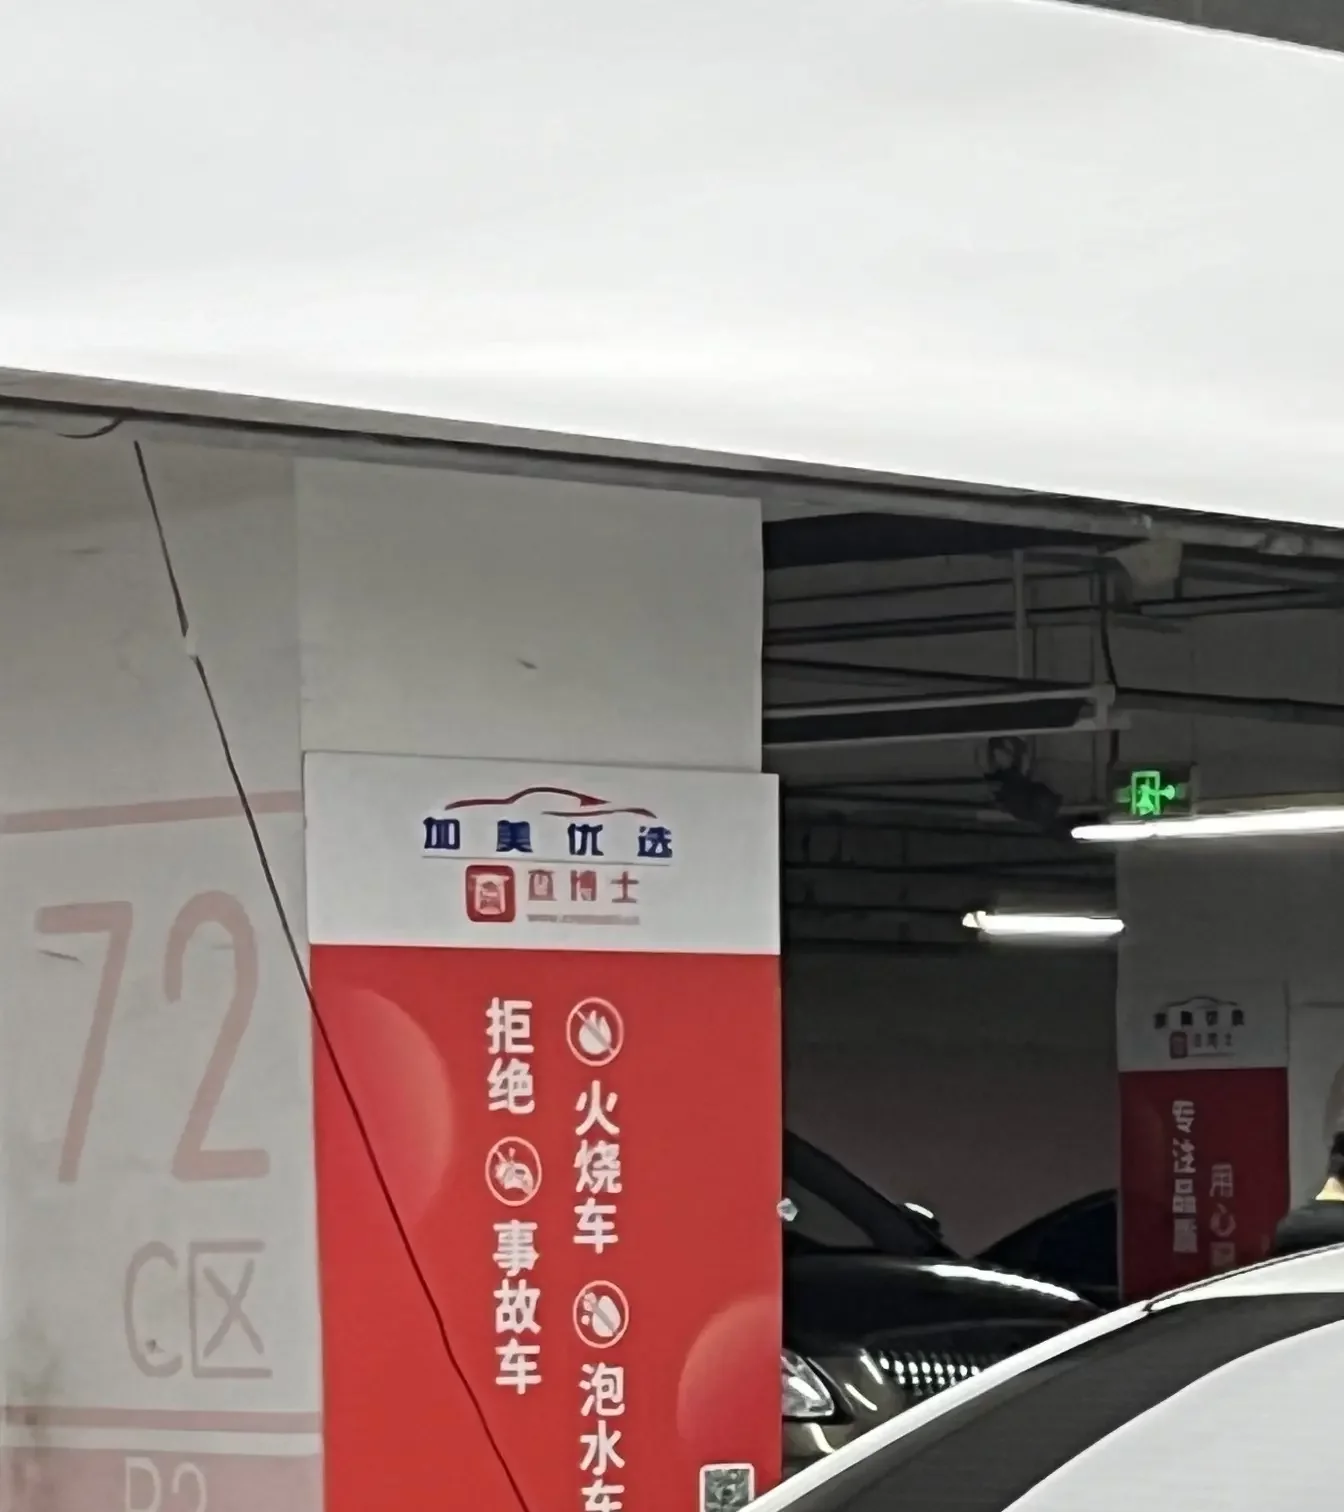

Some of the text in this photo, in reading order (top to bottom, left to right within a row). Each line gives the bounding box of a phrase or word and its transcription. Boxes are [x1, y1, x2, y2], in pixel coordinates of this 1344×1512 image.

[423, 816, 674, 859] 加美优选
[34, 890, 271, 1183] 72
[485, 996, 544, 1395] 拒绝 事故车
[573, 1079, 623, 1255] 火烧车
[123, 1240, 274, 1380] C区
